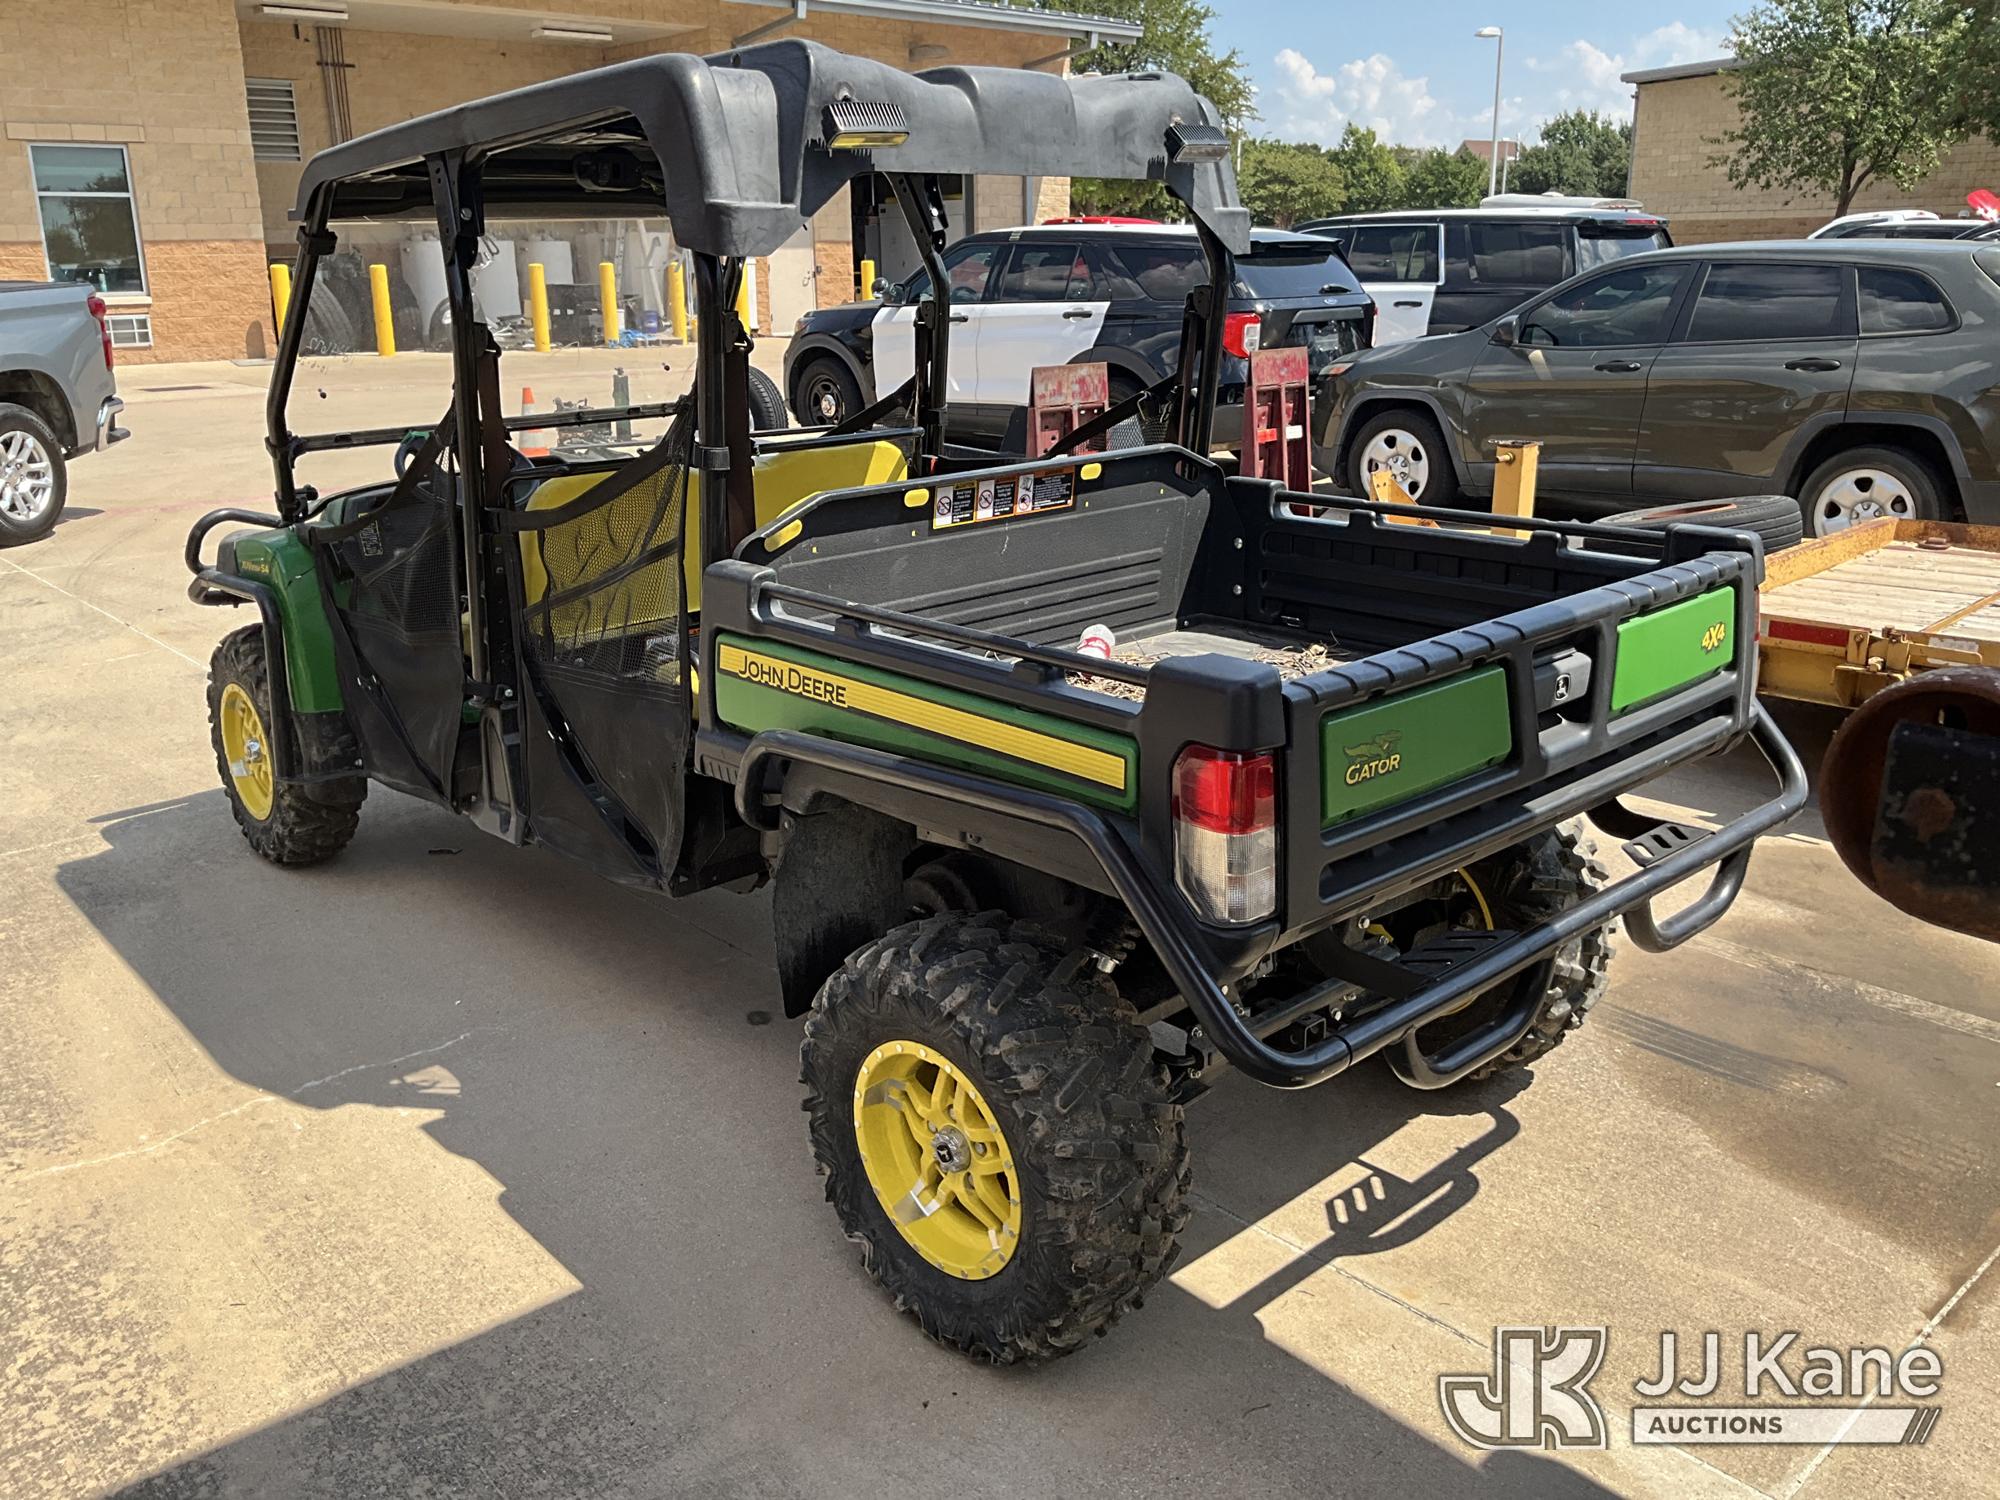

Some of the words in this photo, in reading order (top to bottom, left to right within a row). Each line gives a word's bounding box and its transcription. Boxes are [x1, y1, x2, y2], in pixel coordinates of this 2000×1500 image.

[738, 655, 784, 688] JOHN
[788, 667, 847, 705] DEERE
[1344, 753, 1401, 786] GATOR
